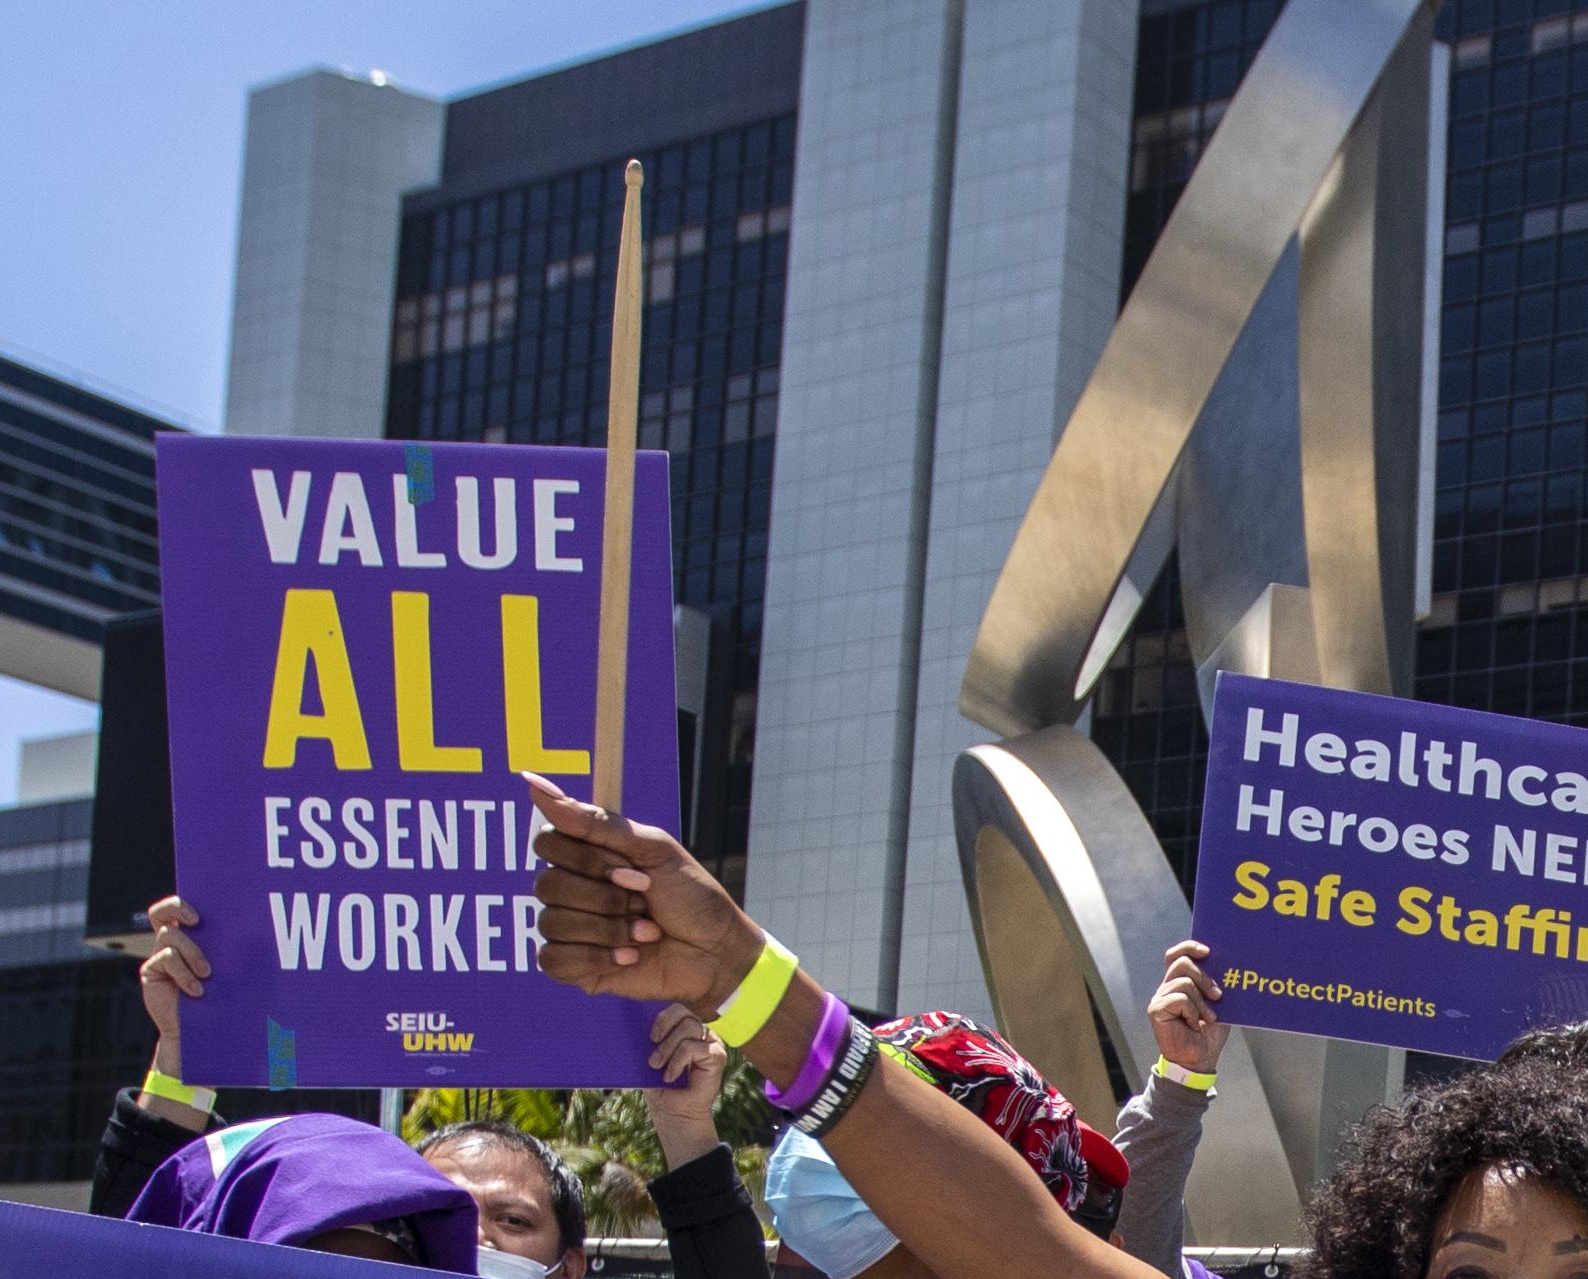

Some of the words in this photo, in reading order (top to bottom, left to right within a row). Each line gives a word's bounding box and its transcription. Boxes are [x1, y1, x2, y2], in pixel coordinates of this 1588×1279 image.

[251, 469, 584, 573] VALUE
[263, 589, 591, 775] ALL
[264, 796, 556, 871] ESSENTIA
[1236, 784, 1470, 865] Heroes
[1232, 860, 1377, 927] Safe
[268, 892, 548, 972] WORKER
[385, 1012, 455, 1032] SEIU-
[1221, 967, 1437, 1019] #ProtectPatients
[402, 1032, 474, 1052] UHW
